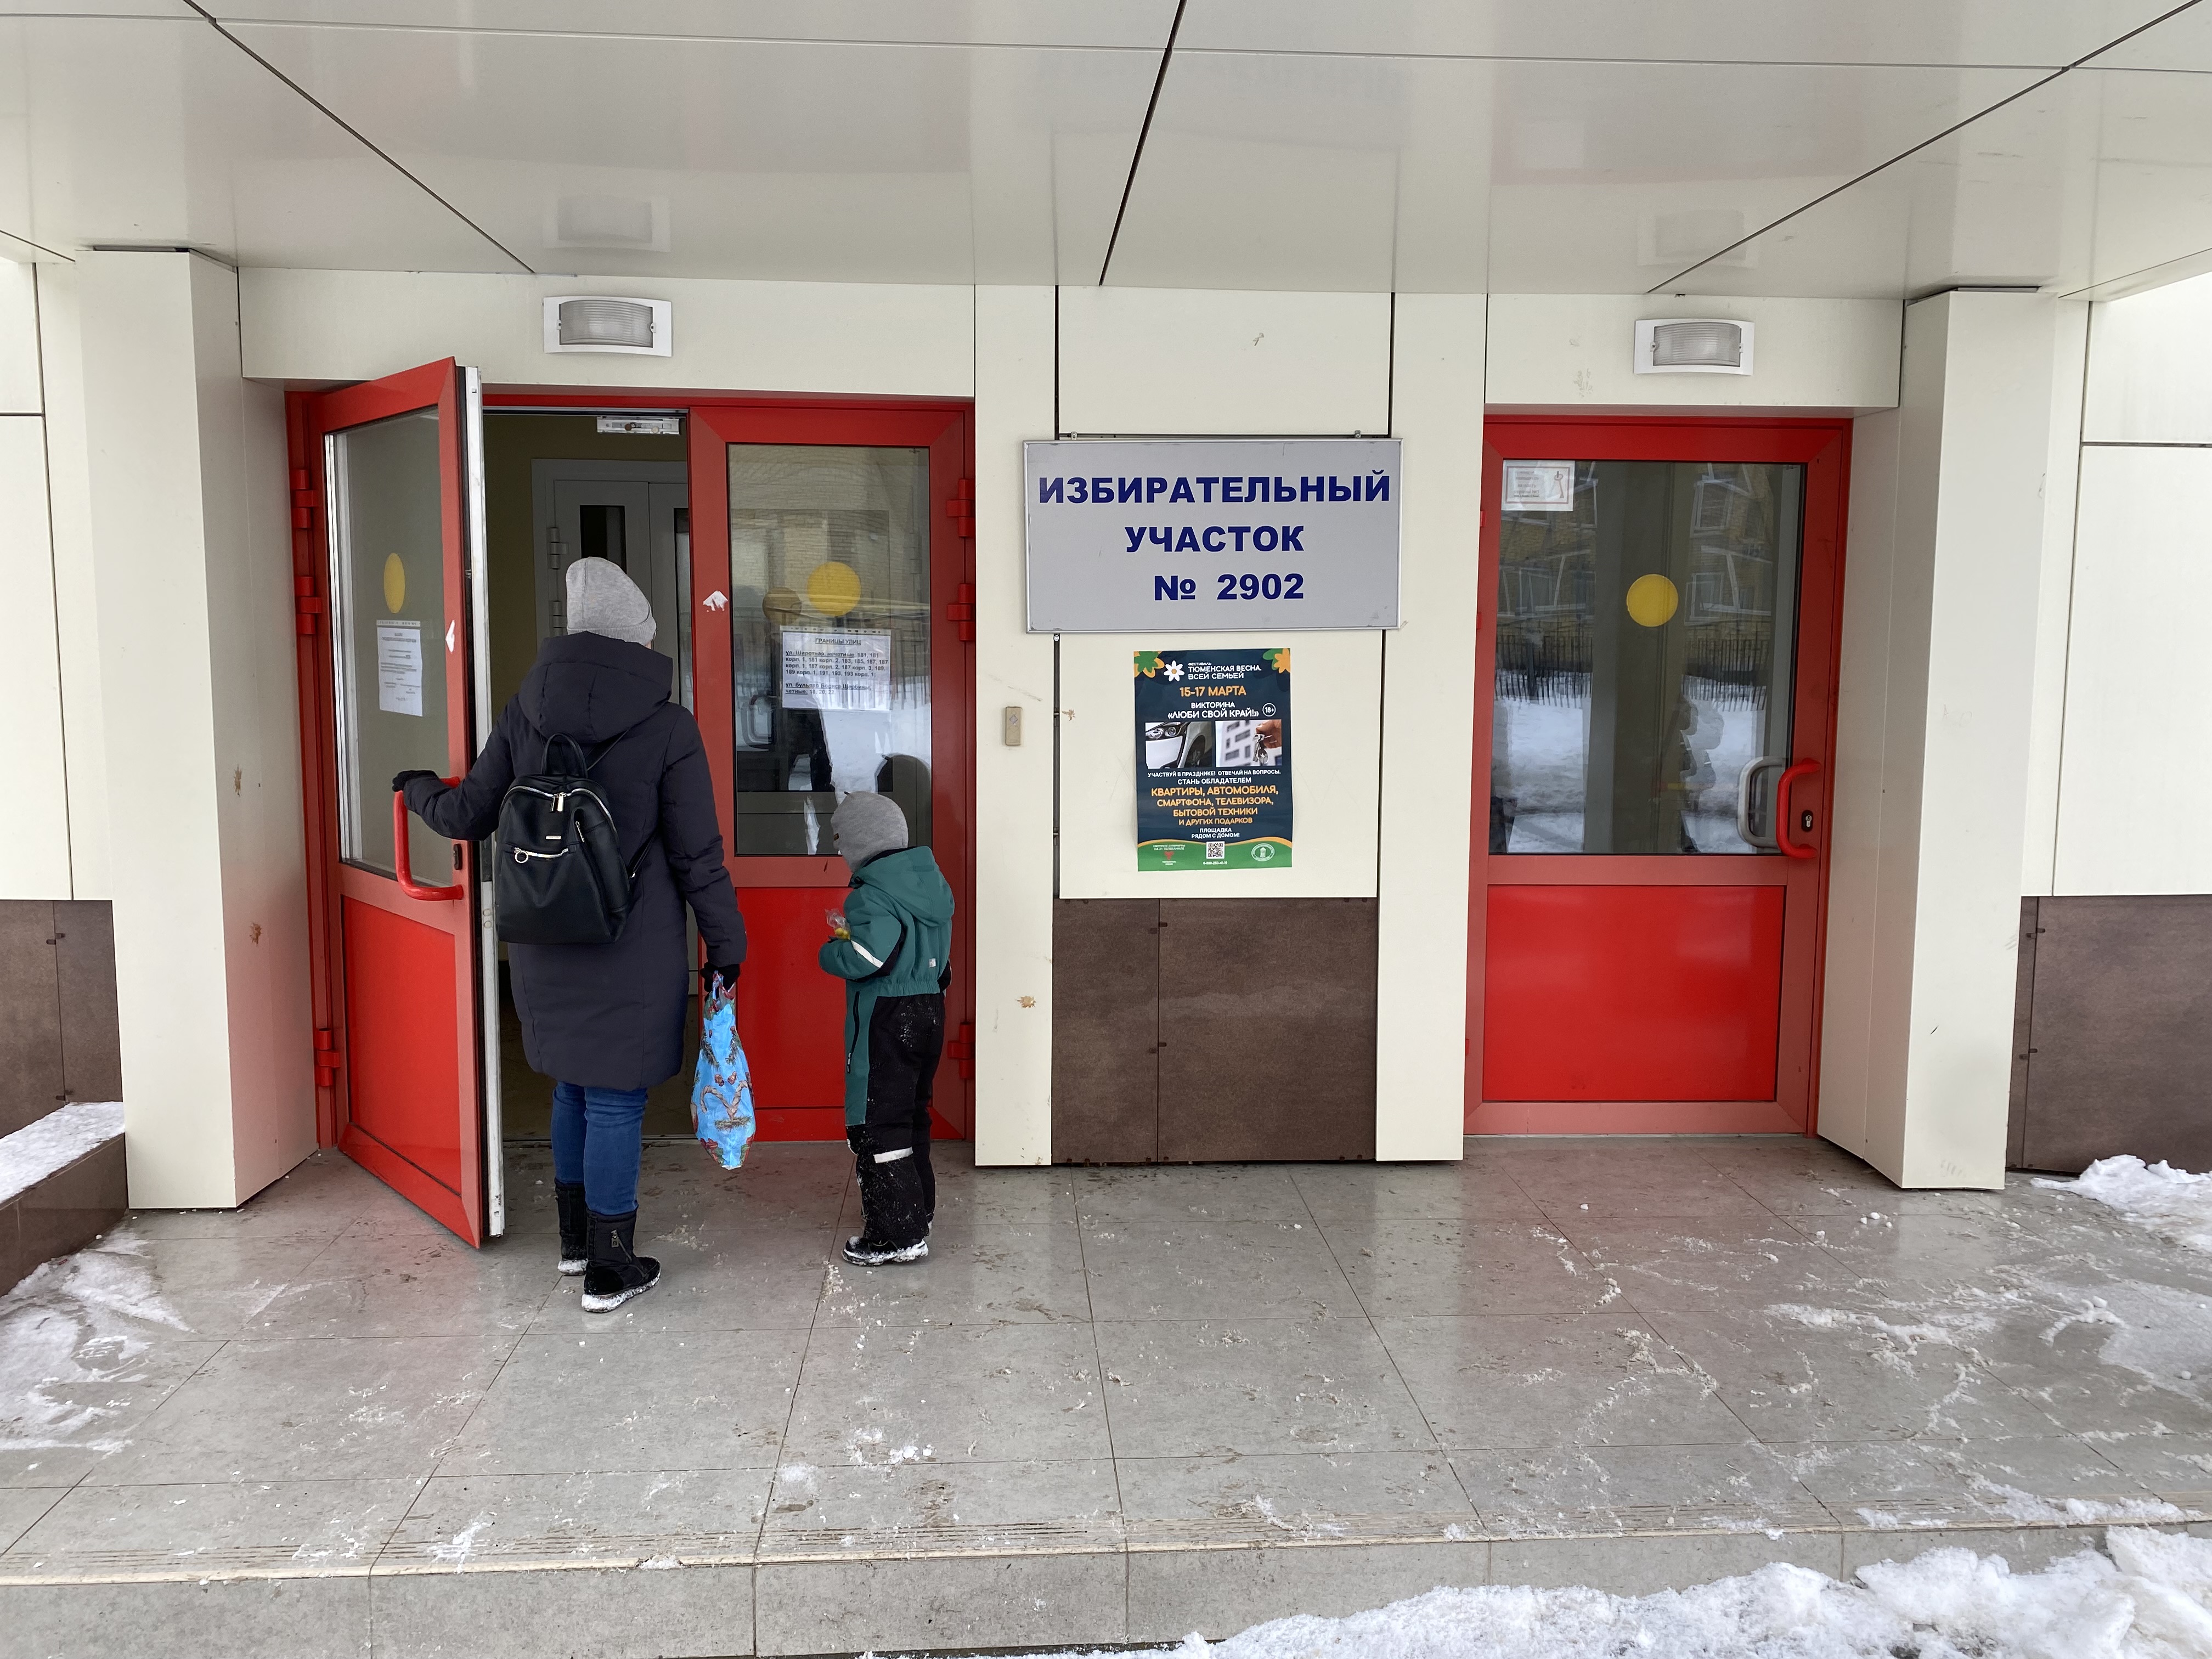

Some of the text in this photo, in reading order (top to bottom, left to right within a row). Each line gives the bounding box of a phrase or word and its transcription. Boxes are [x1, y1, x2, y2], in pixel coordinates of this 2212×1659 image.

[1039, 470, 1390, 504] ИЗБИРАТЕЛЬНЫЙ
[1125, 526, 1305, 552] УЧАСТОК
[1154, 573, 1305, 601] № 2902
[1211, 671, 1244, 679] СЕМЬЕЙ
[1180, 685, 1246, 697] 15-17 МАРТА
[1167, 707, 1260, 719] «ЛЮБИ СВОЙ КРАЙ!»
[1151, 785, 1278, 797] КВАРТИРЫ, АВТОМОБИЛЯ,
[1156, 797, 1274, 806] СМАРТФОНА, ТЕЛЕВИЗОРА,
[1173, 807, 1216, 817] БЫТОВОЙ
